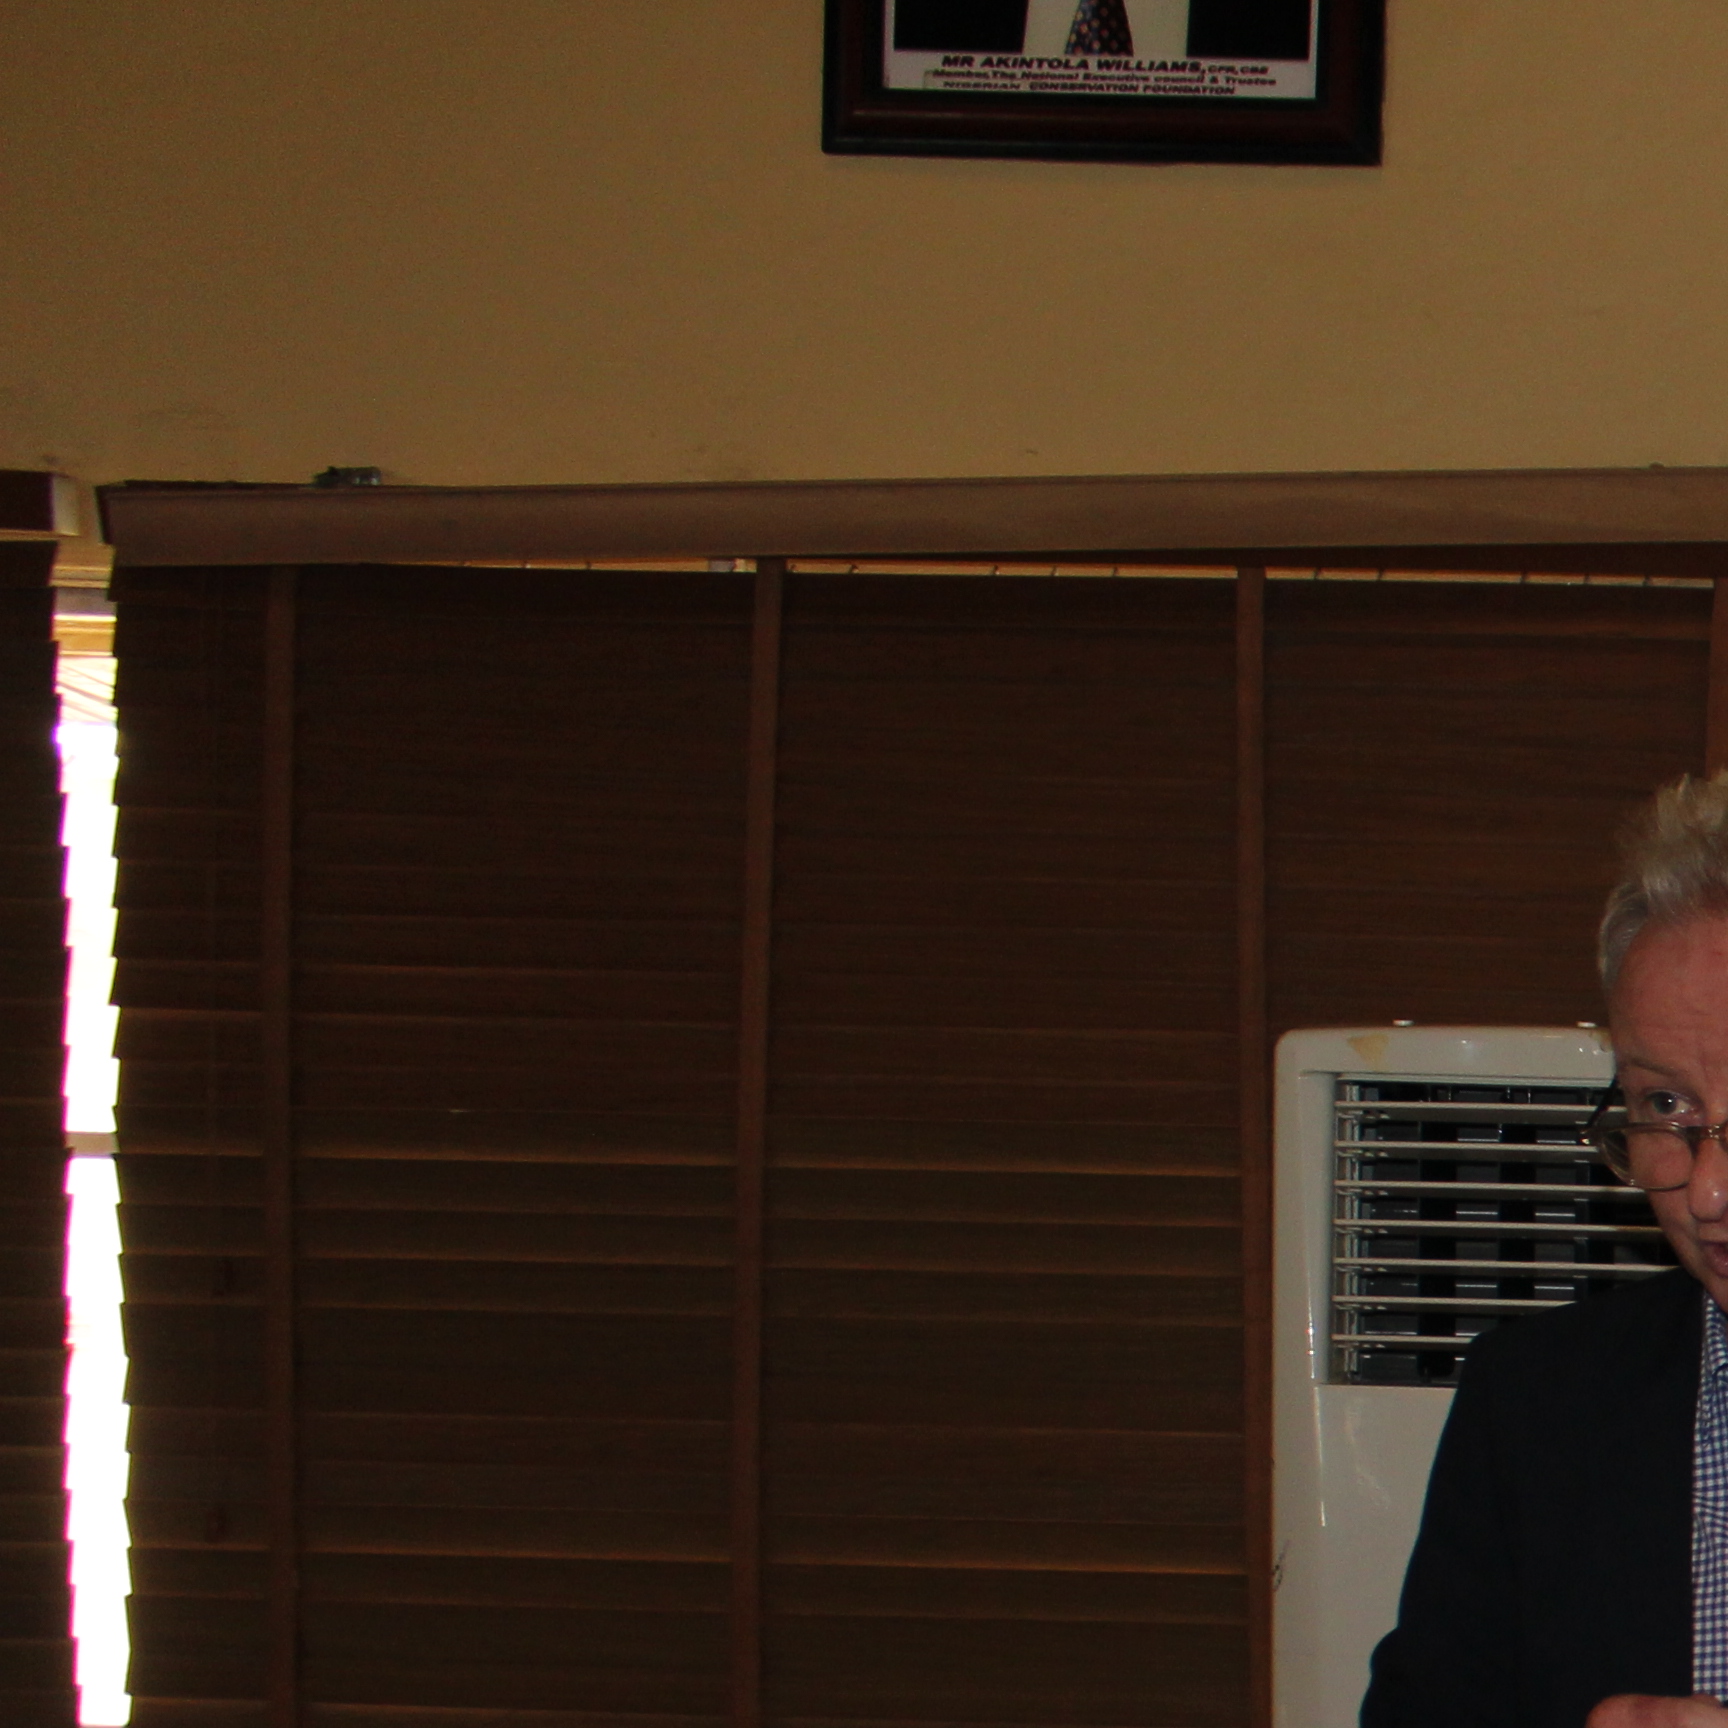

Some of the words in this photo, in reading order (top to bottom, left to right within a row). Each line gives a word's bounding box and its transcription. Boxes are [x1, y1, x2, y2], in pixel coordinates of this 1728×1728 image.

[942, 55, 975, 68] MR
[981, 56, 1089, 70] AKINTOLA
[1021, 71, 1080, 80] National
[943, 80, 1020, 90] NIGERIAN
[1029, 81, 1139, 93] CONSERVATION
[1143, 84, 1235, 95] FOUNDATION
